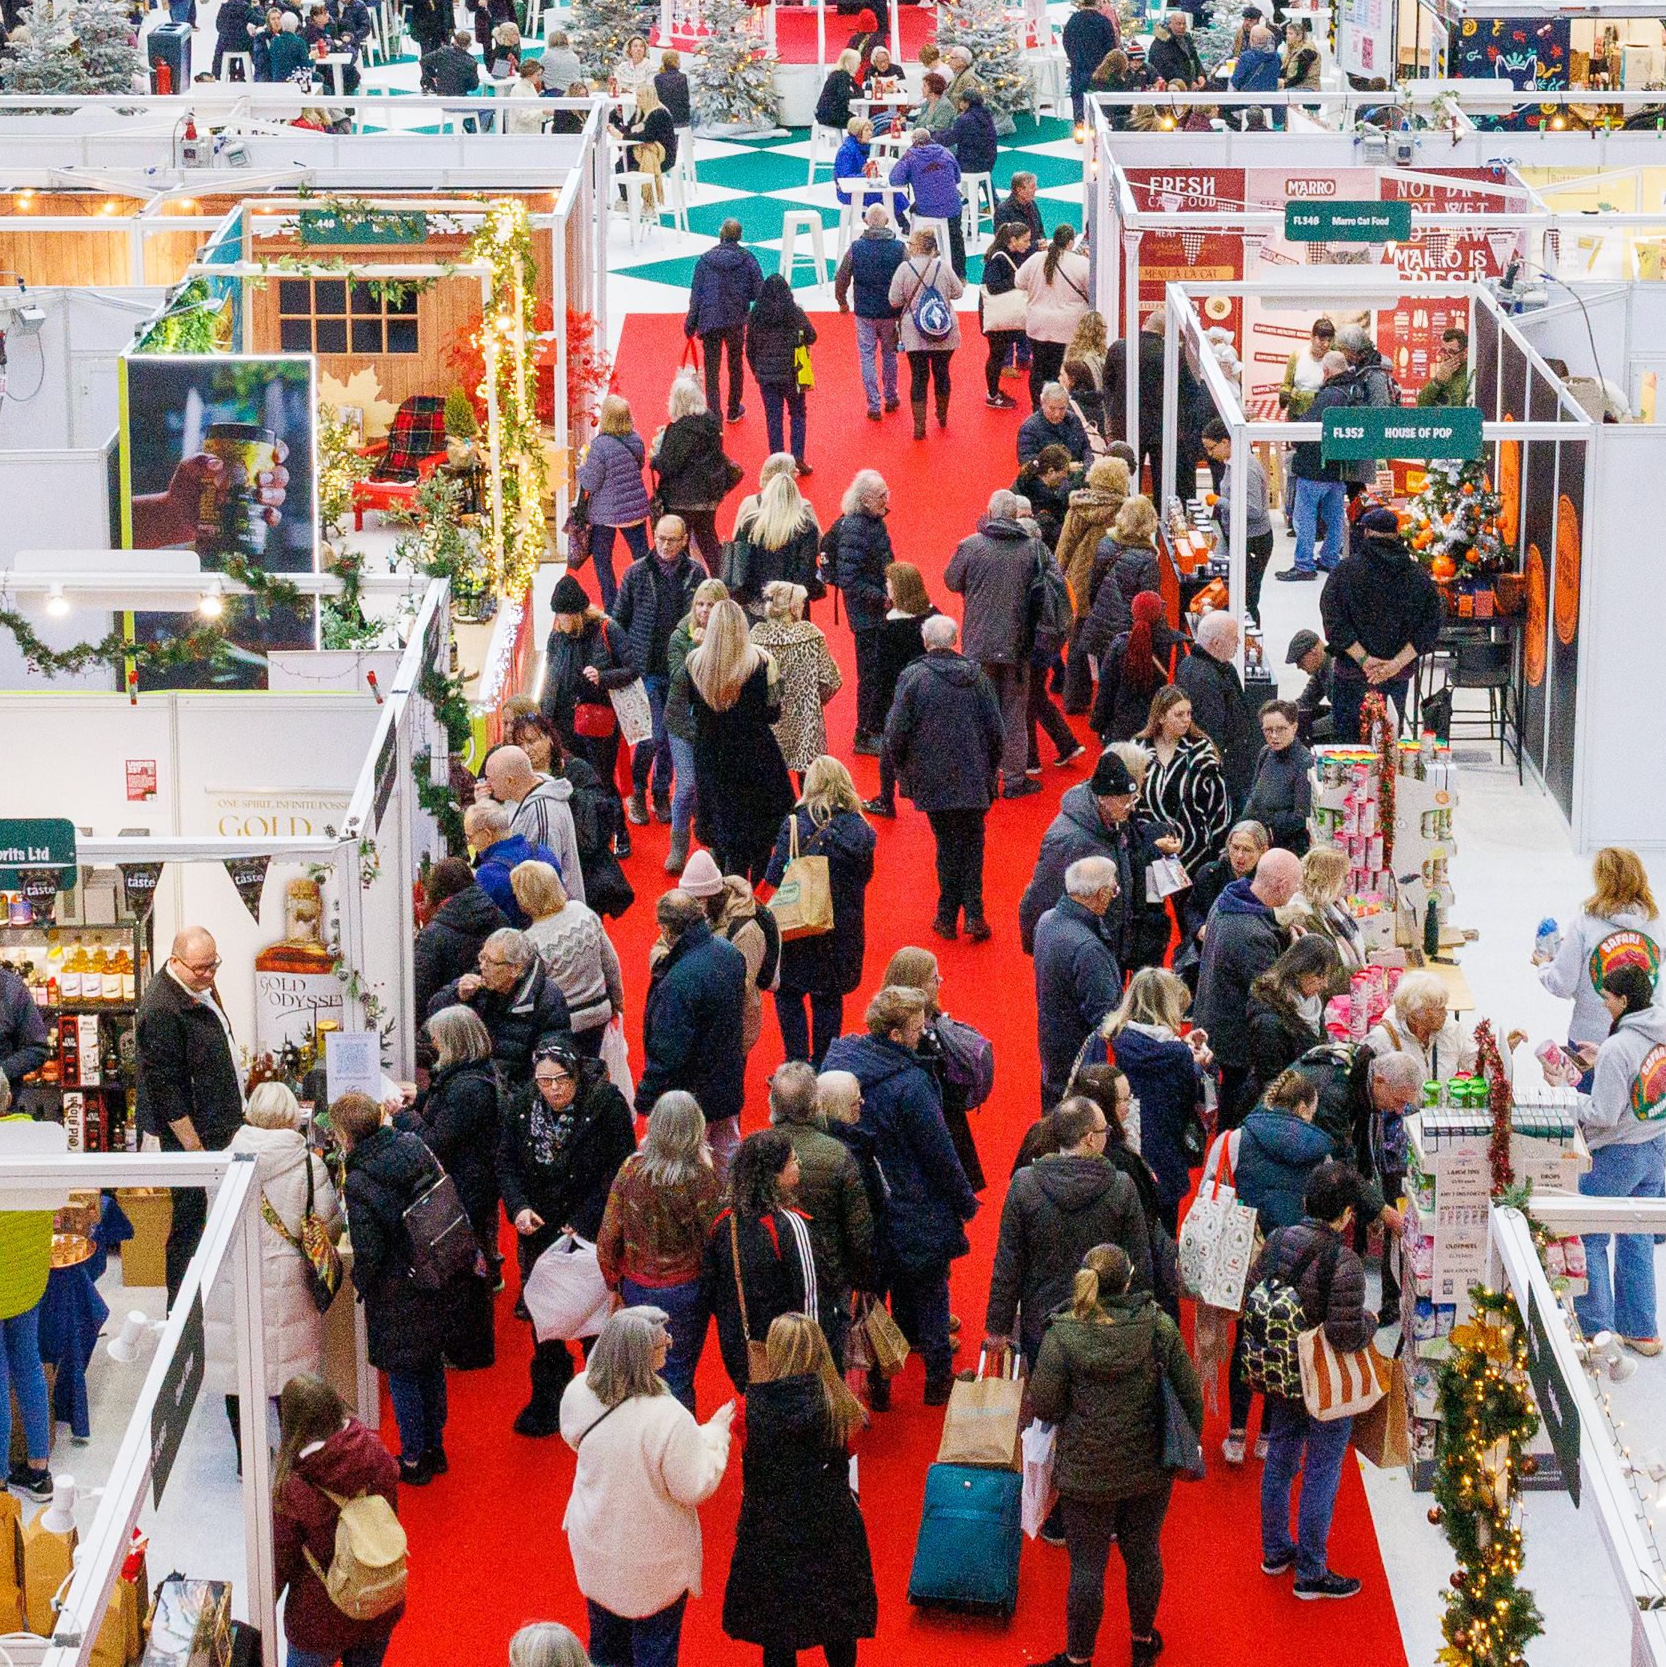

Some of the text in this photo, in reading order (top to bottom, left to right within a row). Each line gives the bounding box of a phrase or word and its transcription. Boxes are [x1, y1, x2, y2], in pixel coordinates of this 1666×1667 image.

[1149, 176, 1216, 196] FRESH
[1396, 180, 1433, 198] NOT
[1182, 197, 1216, 208] FOOD
[1332, 215, 1389, 225] Marro Cat Food
[1467, 249, 1487, 267] IS
[1333, 426, 1452, 438] FL352 HOUSE OF POP
[218, 799, 237, 810] ONE
[271, 799, 310, 810] INFINITE
[28, 846, 49, 861] Ltd
[260, 975, 307, 1000] GOLD
